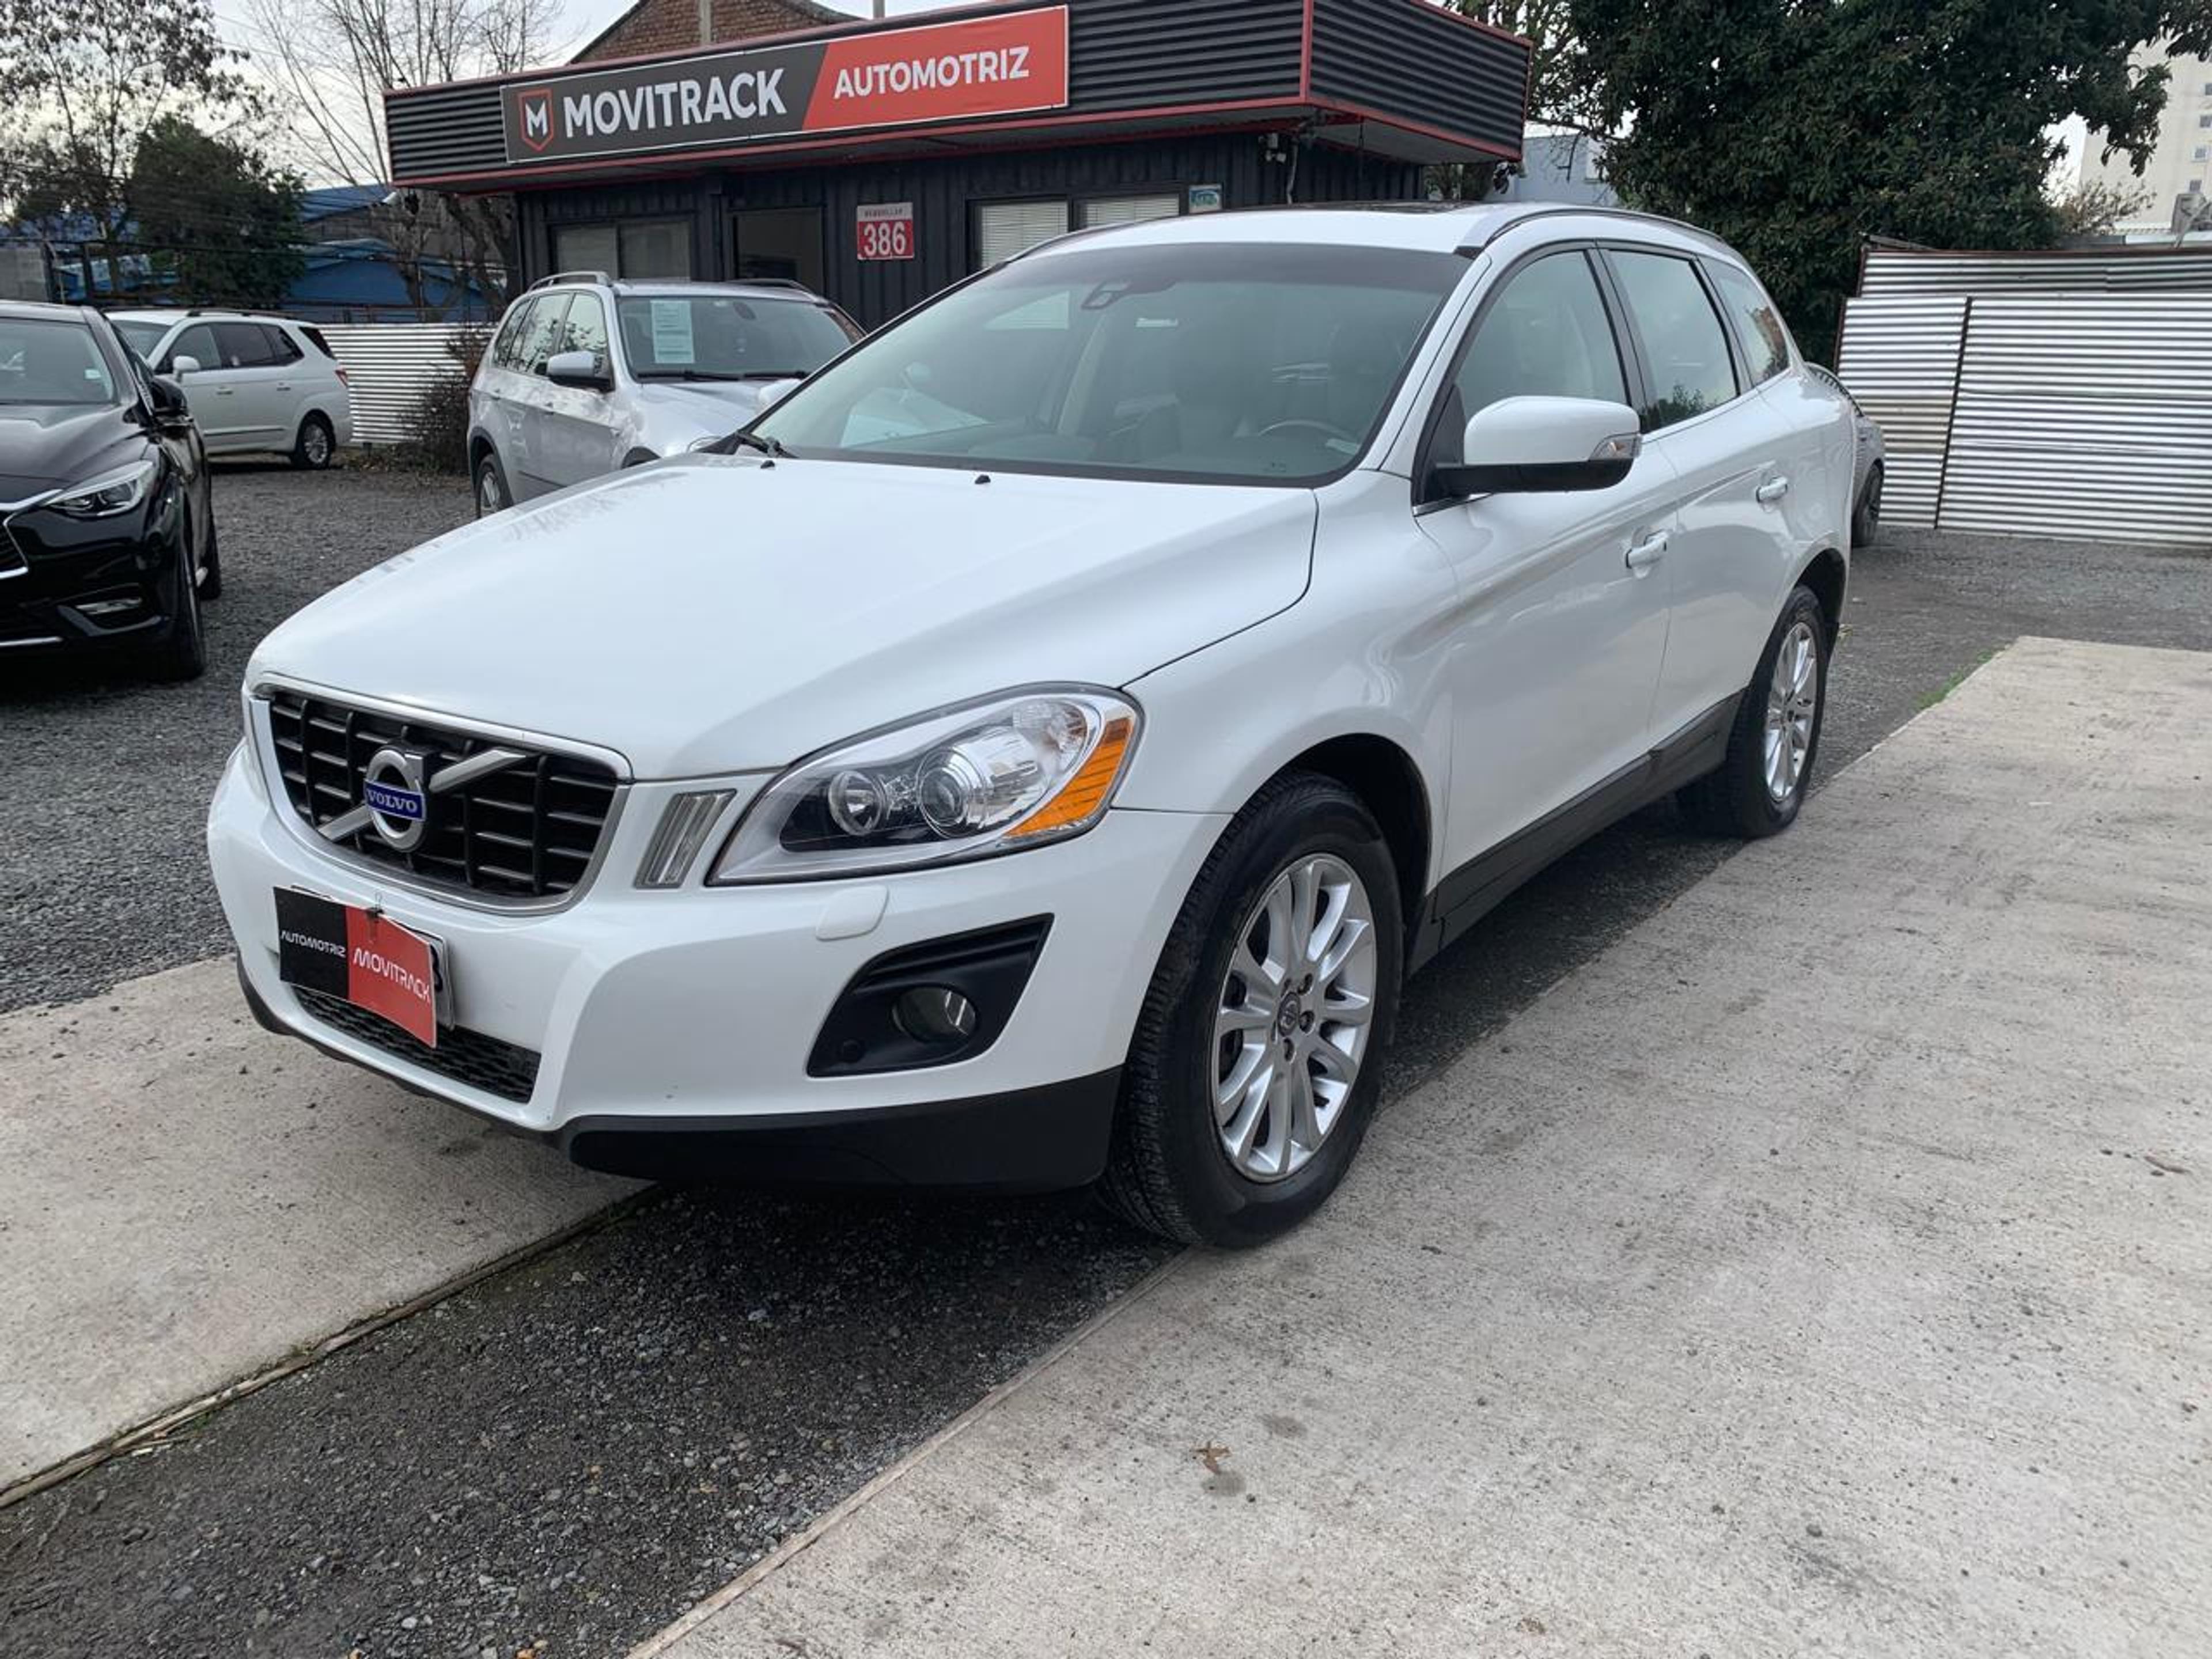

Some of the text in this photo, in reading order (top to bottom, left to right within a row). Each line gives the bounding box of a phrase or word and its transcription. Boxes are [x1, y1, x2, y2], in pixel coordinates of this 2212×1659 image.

[525, 46, 1030, 138] M MOVITRACK AUTOMOTRIZ
[863, 221, 907, 257] 386
[366, 789, 418, 813] VOLVO
[281, 930, 431, 1005] AUTOMOTRIZ MOVITRACK
